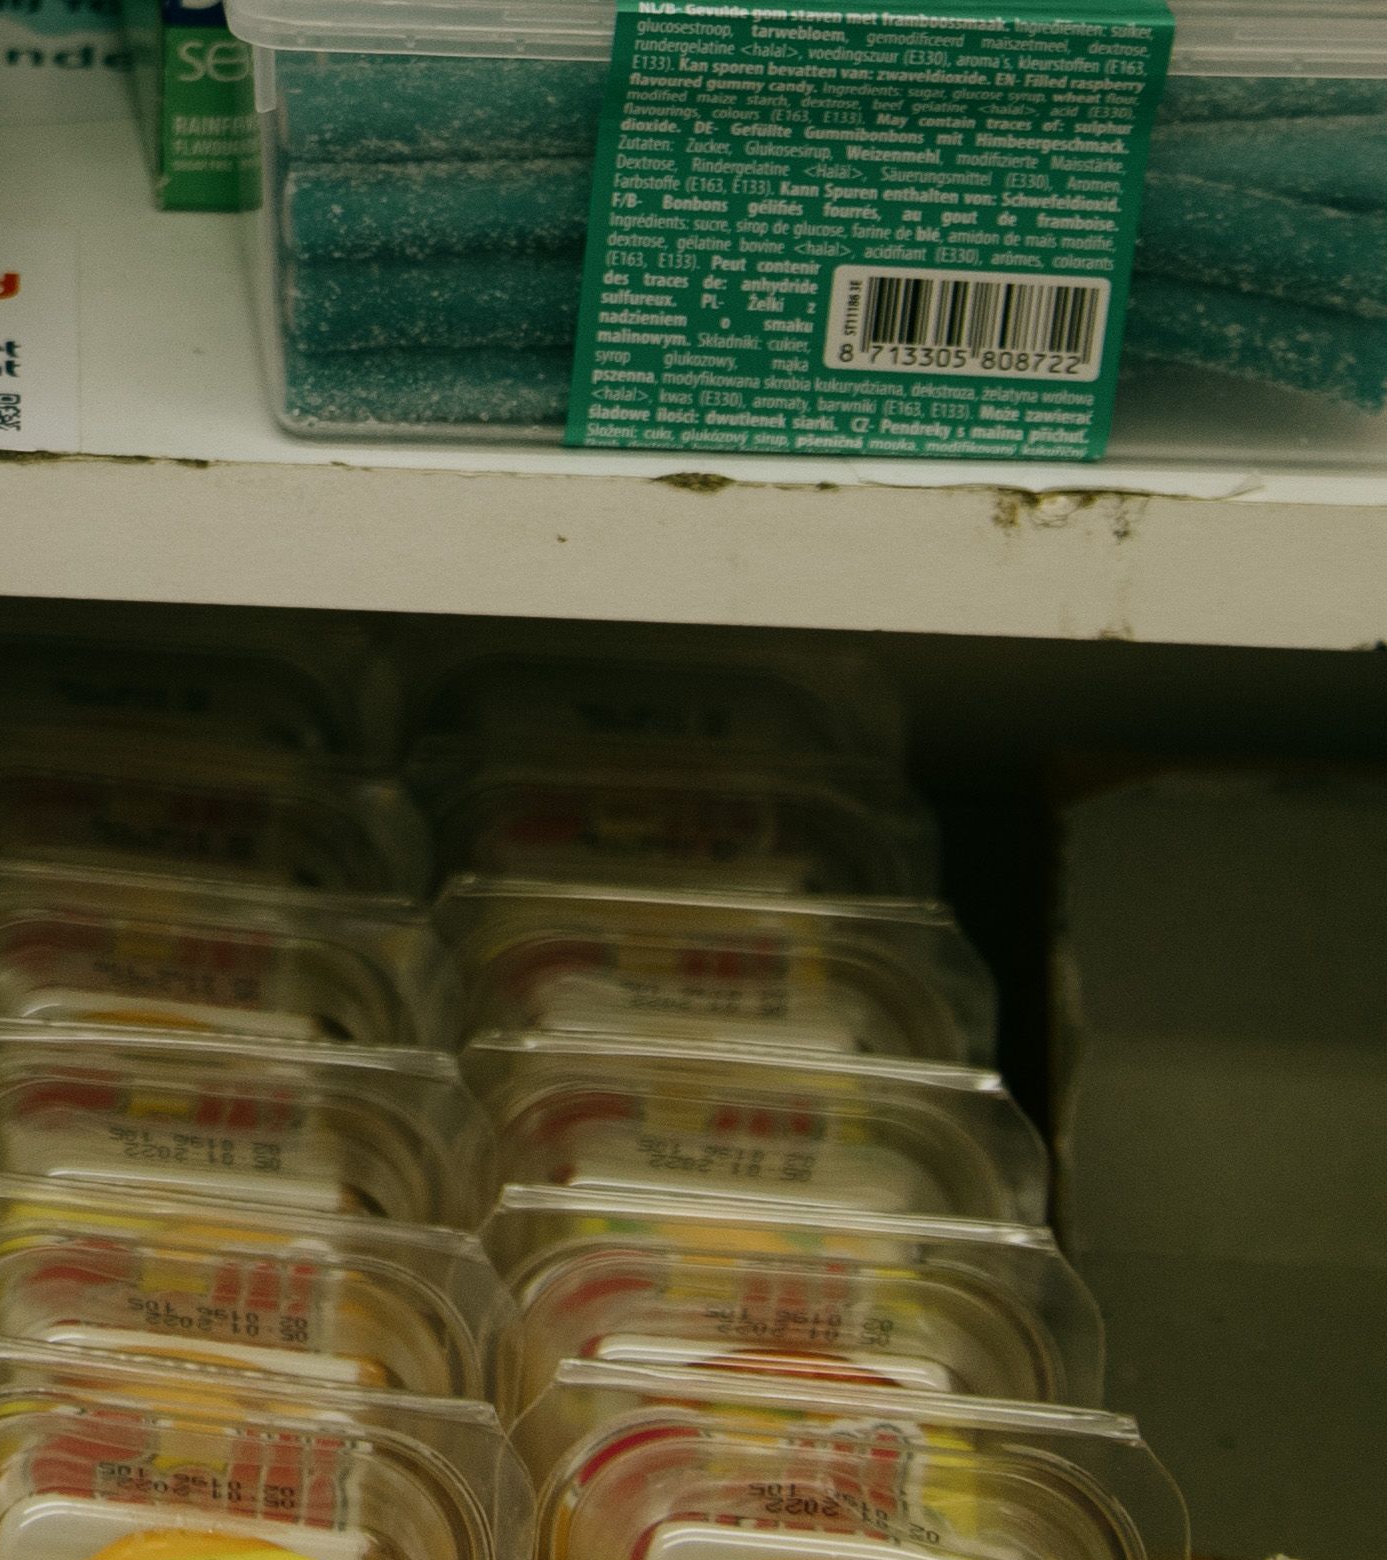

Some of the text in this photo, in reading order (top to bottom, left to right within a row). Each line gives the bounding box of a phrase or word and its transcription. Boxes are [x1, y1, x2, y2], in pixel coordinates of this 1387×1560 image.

[636, 19, 733, 40] glucosestroop,
[750, 24, 849, 45] tarwebloem,
[634, 37, 735, 58] rundergelatine
[808, 45, 899, 65] voedingszuur
[904, 49, 952, 68] (E330),
[679, 58, 709, 72] Kan
[712, 62, 764, 76] sporen
[768, 61, 837, 78] bevatten
[840, 66, 874, 79] van:
[876, 65, 989, 84] zwaveldioxide.
[1025, 72, 1068, 89] Filled
[1070, 77, 1145, 93] raspberry
[618, 135, 673, 151] Zutaten:
[686, 138, 732, 157] Zucker,
[744, 141, 833, 161] Glukosesirup,
[845, 145, 943, 166] Weizenmehl,
[956, 151, 1039, 168] modifizierte
[620, 117, 1130, 156] dioxide. DE- Gefüllte Gummibonbons mit Himbeergeschmack.
[615, 153, 678, 172] Dextrose,
[691, 156, 790, 178] Rindergelatine
[881, 165, 992, 187] Säuerungsmittel
[1005, 172, 1052, 191] (E330),
[614, 173, 1123, 211] Farbstoffe (E163, E133). Kann Spuren enthalten von: Schwefeldioxid.
[611, 192, 642, 208] F/B-
[662, 195, 729, 212] Bonbons
[747, 199, 804, 218] gélifiés
[822, 202, 882, 221] fourrés,
[902, 208, 922, 221] au
[997, 210, 1017, 225] de
[1036, 212, 1119, 230] framboise.
[605, 251, 821, 274] (E163, E133). Peut contenir
[602, 271, 819, 295] des traces de: anhydride
[600, 291, 677, 307] sulfureux.
[700, 294, 724, 309] PL-
[807, 300, 816, 312] z
[598, 310, 813, 331] nadzieniem o smaku
[596, 329, 691, 350] malinowym.
[838, 343, 1082, 375] 8 713305 808722
